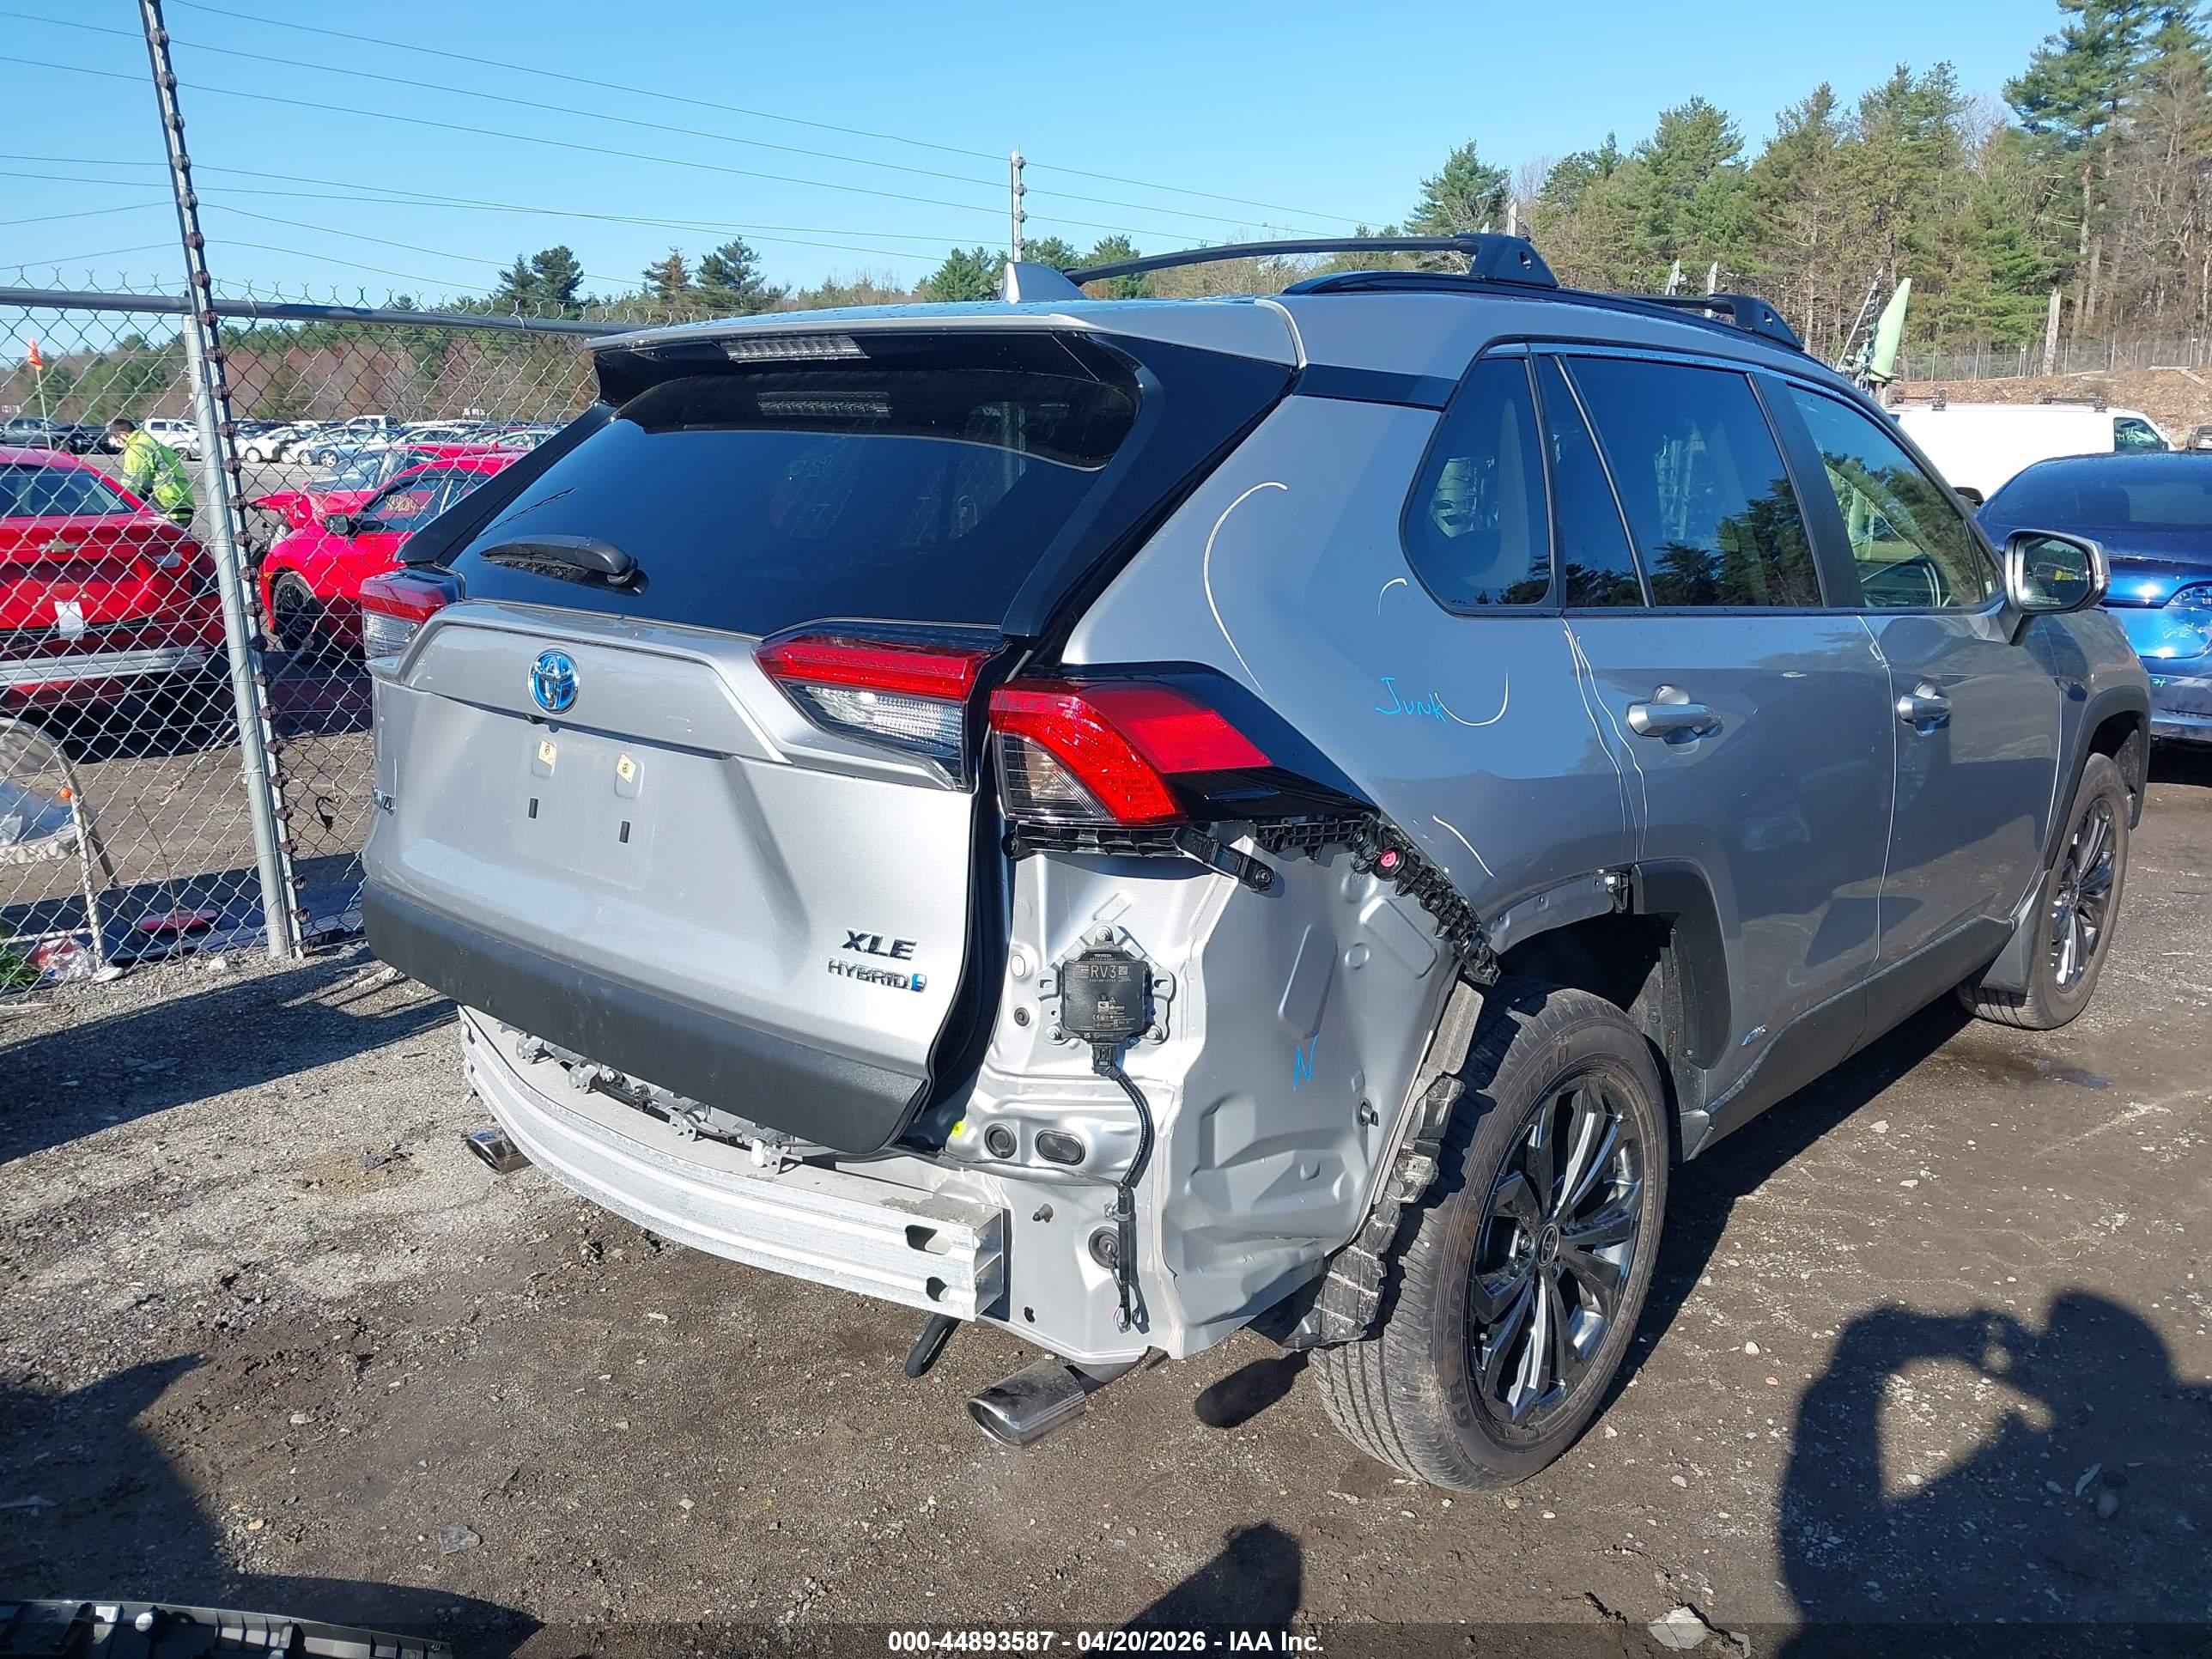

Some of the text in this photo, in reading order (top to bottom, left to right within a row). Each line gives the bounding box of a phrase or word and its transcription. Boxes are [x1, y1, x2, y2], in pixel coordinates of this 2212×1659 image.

[839, 927, 919, 962] XLE
[827, 957, 910, 990] HYBRID
[1091, 964, 1117, 979] RV3
